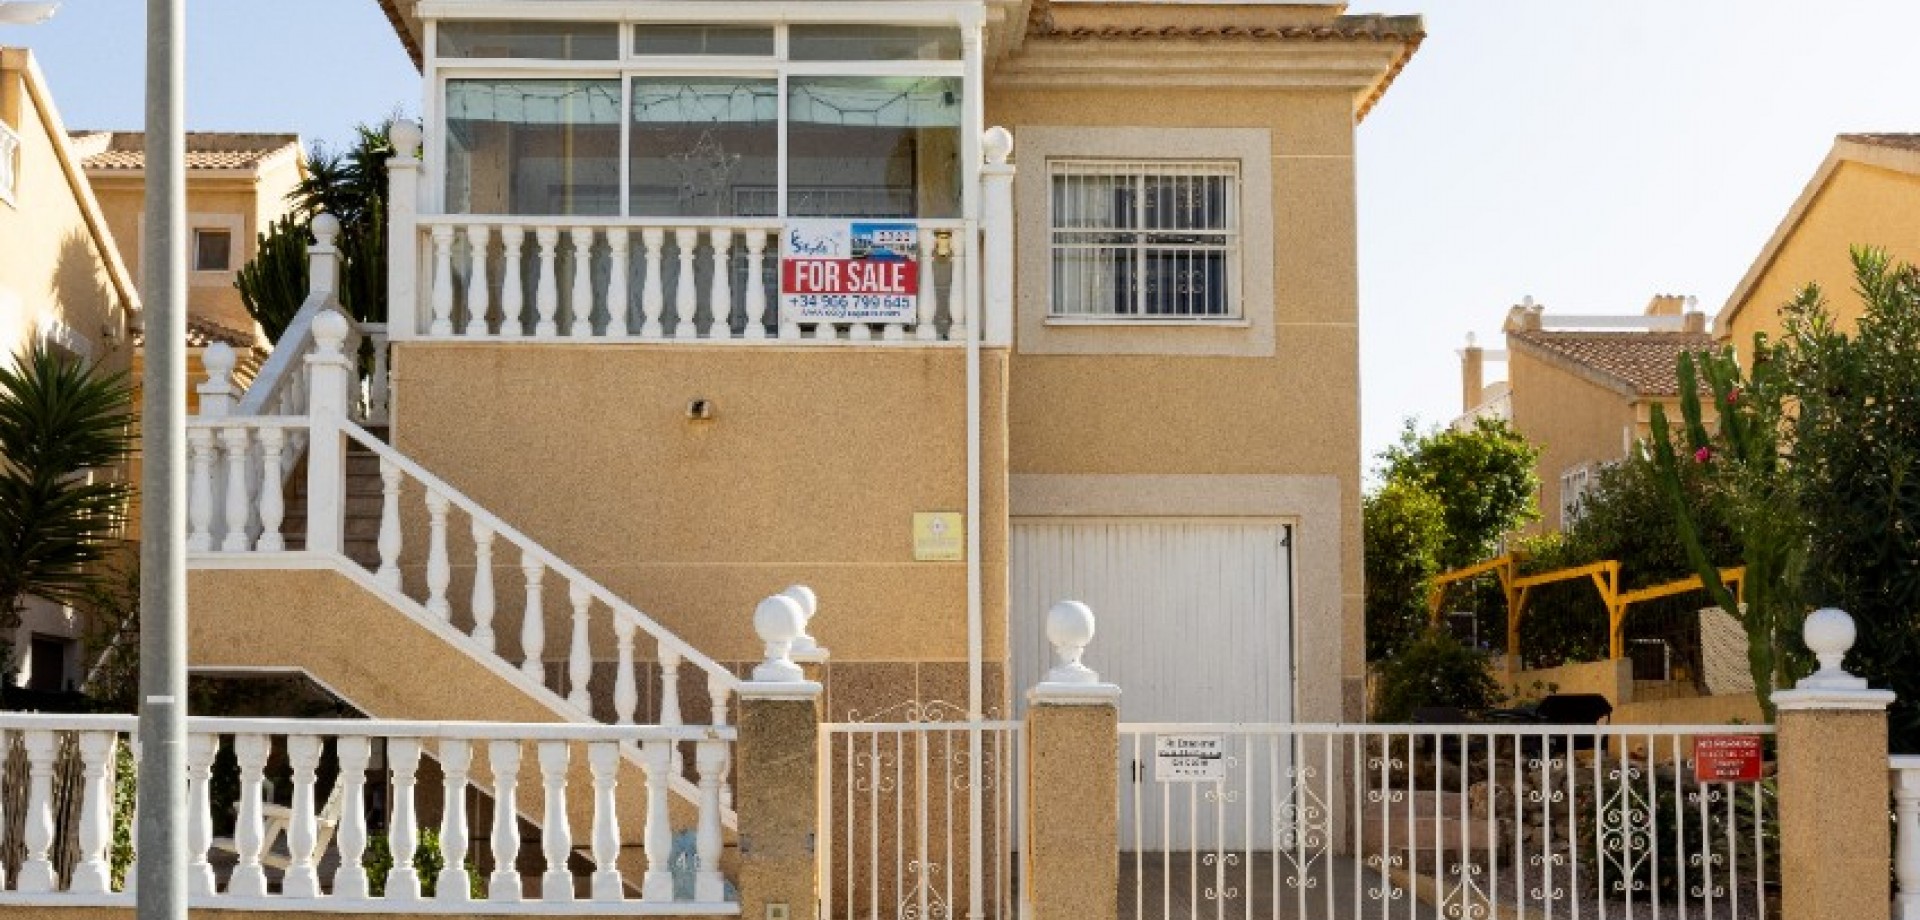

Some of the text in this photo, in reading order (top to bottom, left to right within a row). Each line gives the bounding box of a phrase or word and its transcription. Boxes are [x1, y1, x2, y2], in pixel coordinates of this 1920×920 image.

[795, 261, 906, 292] FOR SALE
[789, 295, 817, 308] +34
[852, 295, 881, 309] 799
[884, 295, 910, 309] 645
